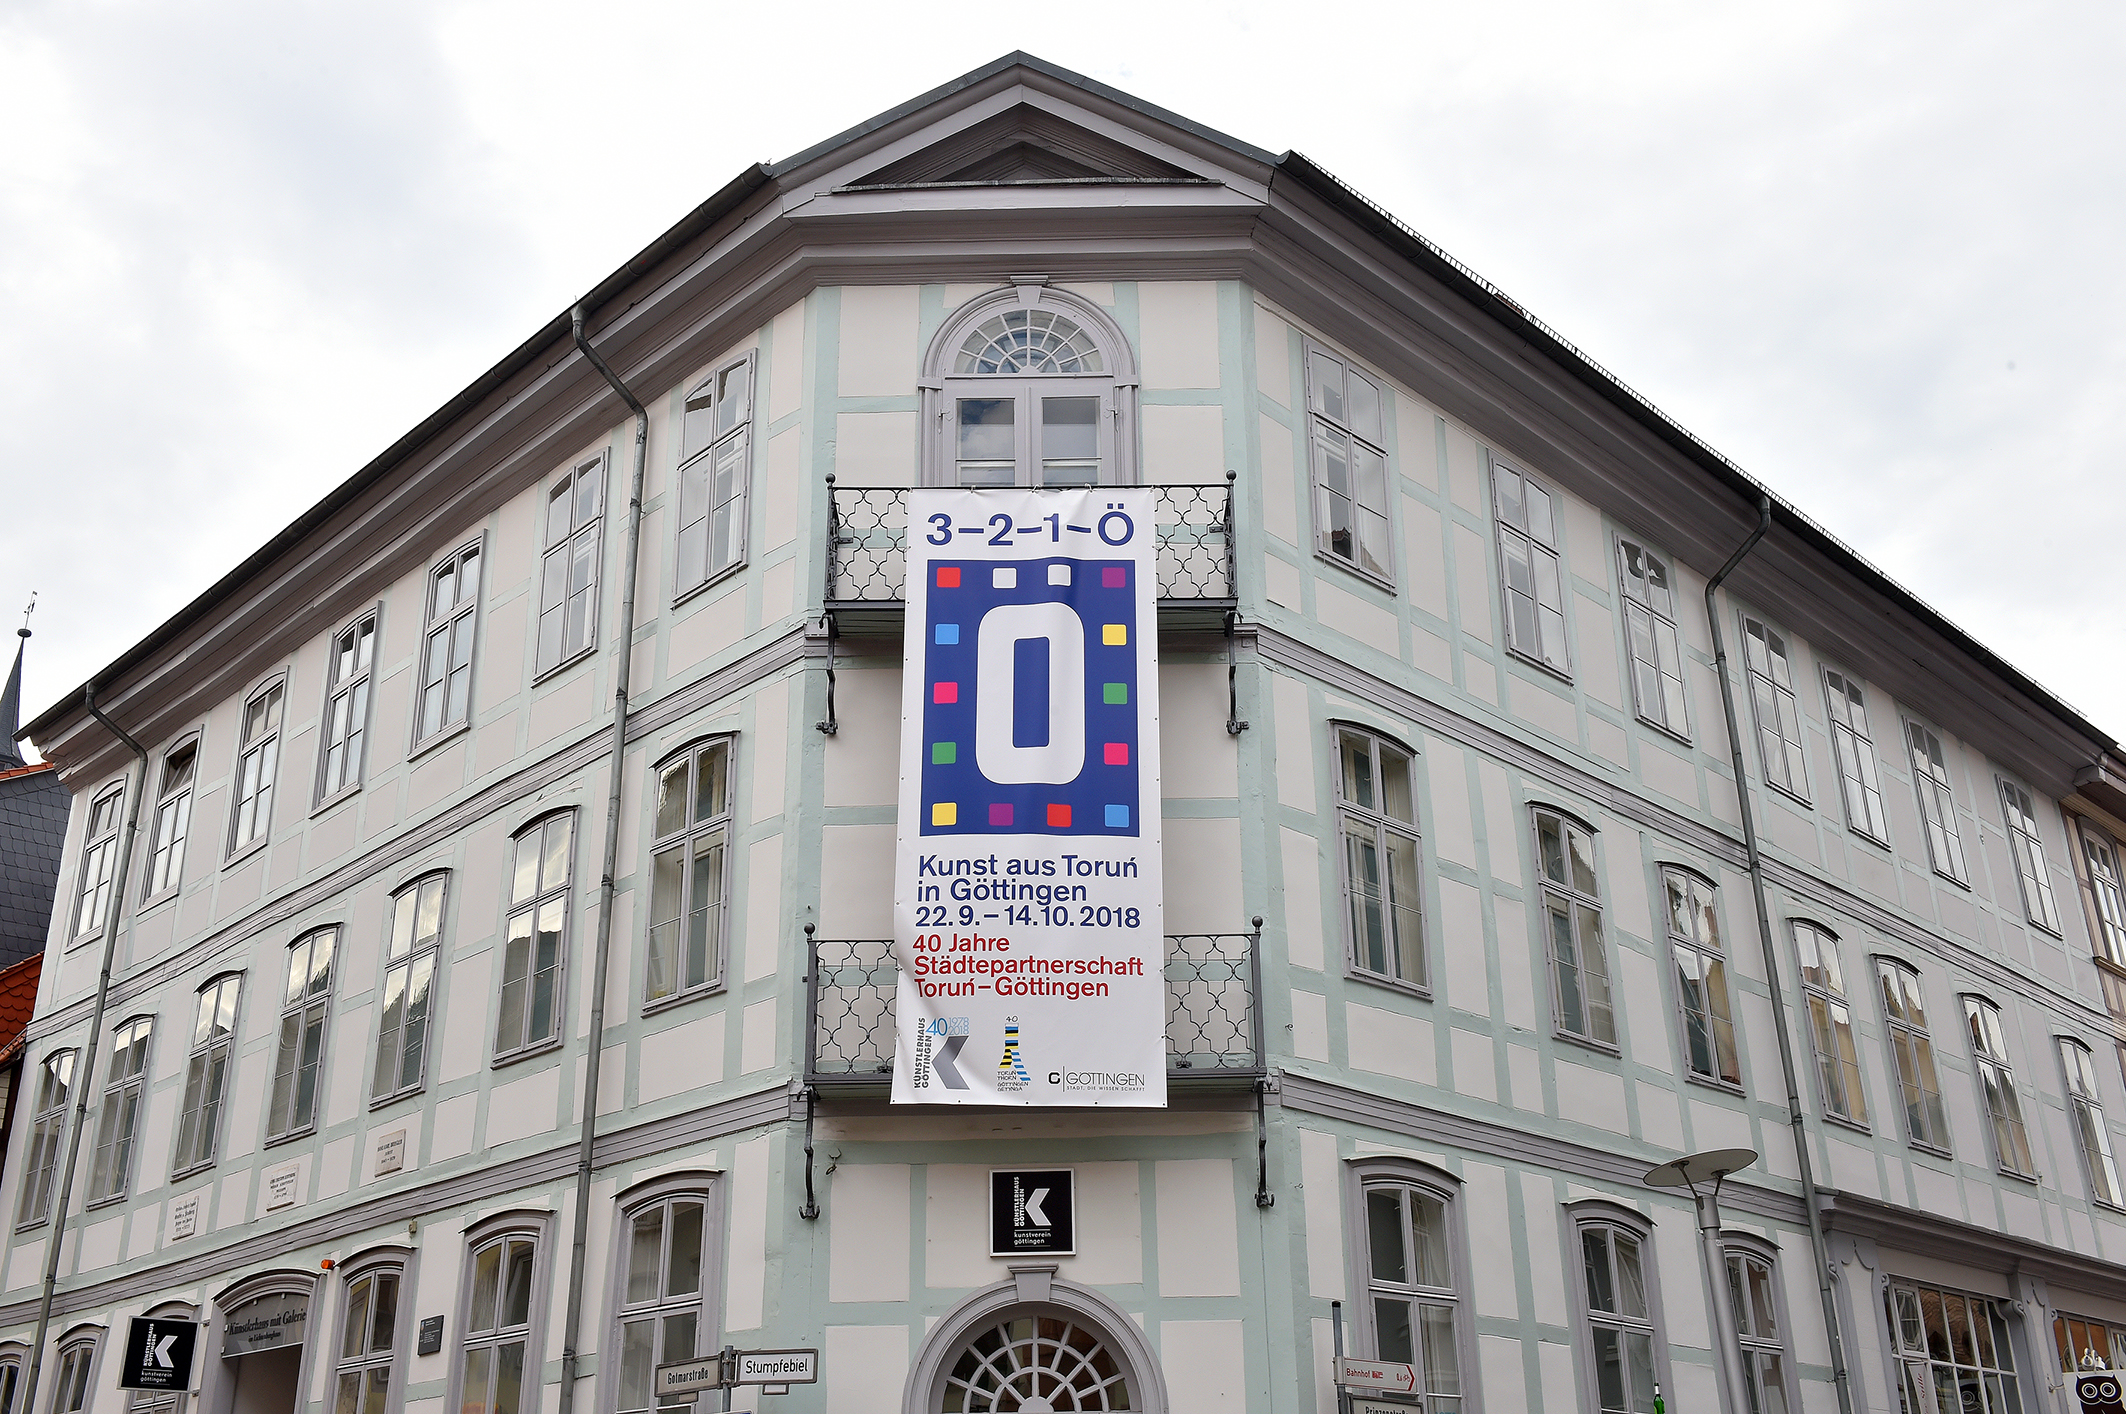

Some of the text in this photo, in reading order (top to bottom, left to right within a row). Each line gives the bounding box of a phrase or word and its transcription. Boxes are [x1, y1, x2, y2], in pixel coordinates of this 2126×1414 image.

[918, 854, 1138, 878] Kunst aus Toruń
[918, 878, 1088, 906] in Göttingen
[912, 933, 1010, 952] 40 Jahre
[914, 954, 1144, 977] Städtepartnerschaft
[926, 1018, 948, 1036] 40
[949, 1017, 969, 1027] 1978
[949, 1026, 969, 1035] 2018
[913, 1017, 926, 1088] KÜNSTLERHAUS
[922, 1035, 932, 1088] GÖTTINGEN
[1066, 1071, 1144, 1086] GÖTTINGEN
[229, 1308, 306, 1335] Künstlerhaus mit Galerie
[668, 1367, 708, 1385] Gotmarstraße
[746, 1358, 808, 1376] Stumpfebiel
[1346, 1368, 1370, 1378] Bahnhof
